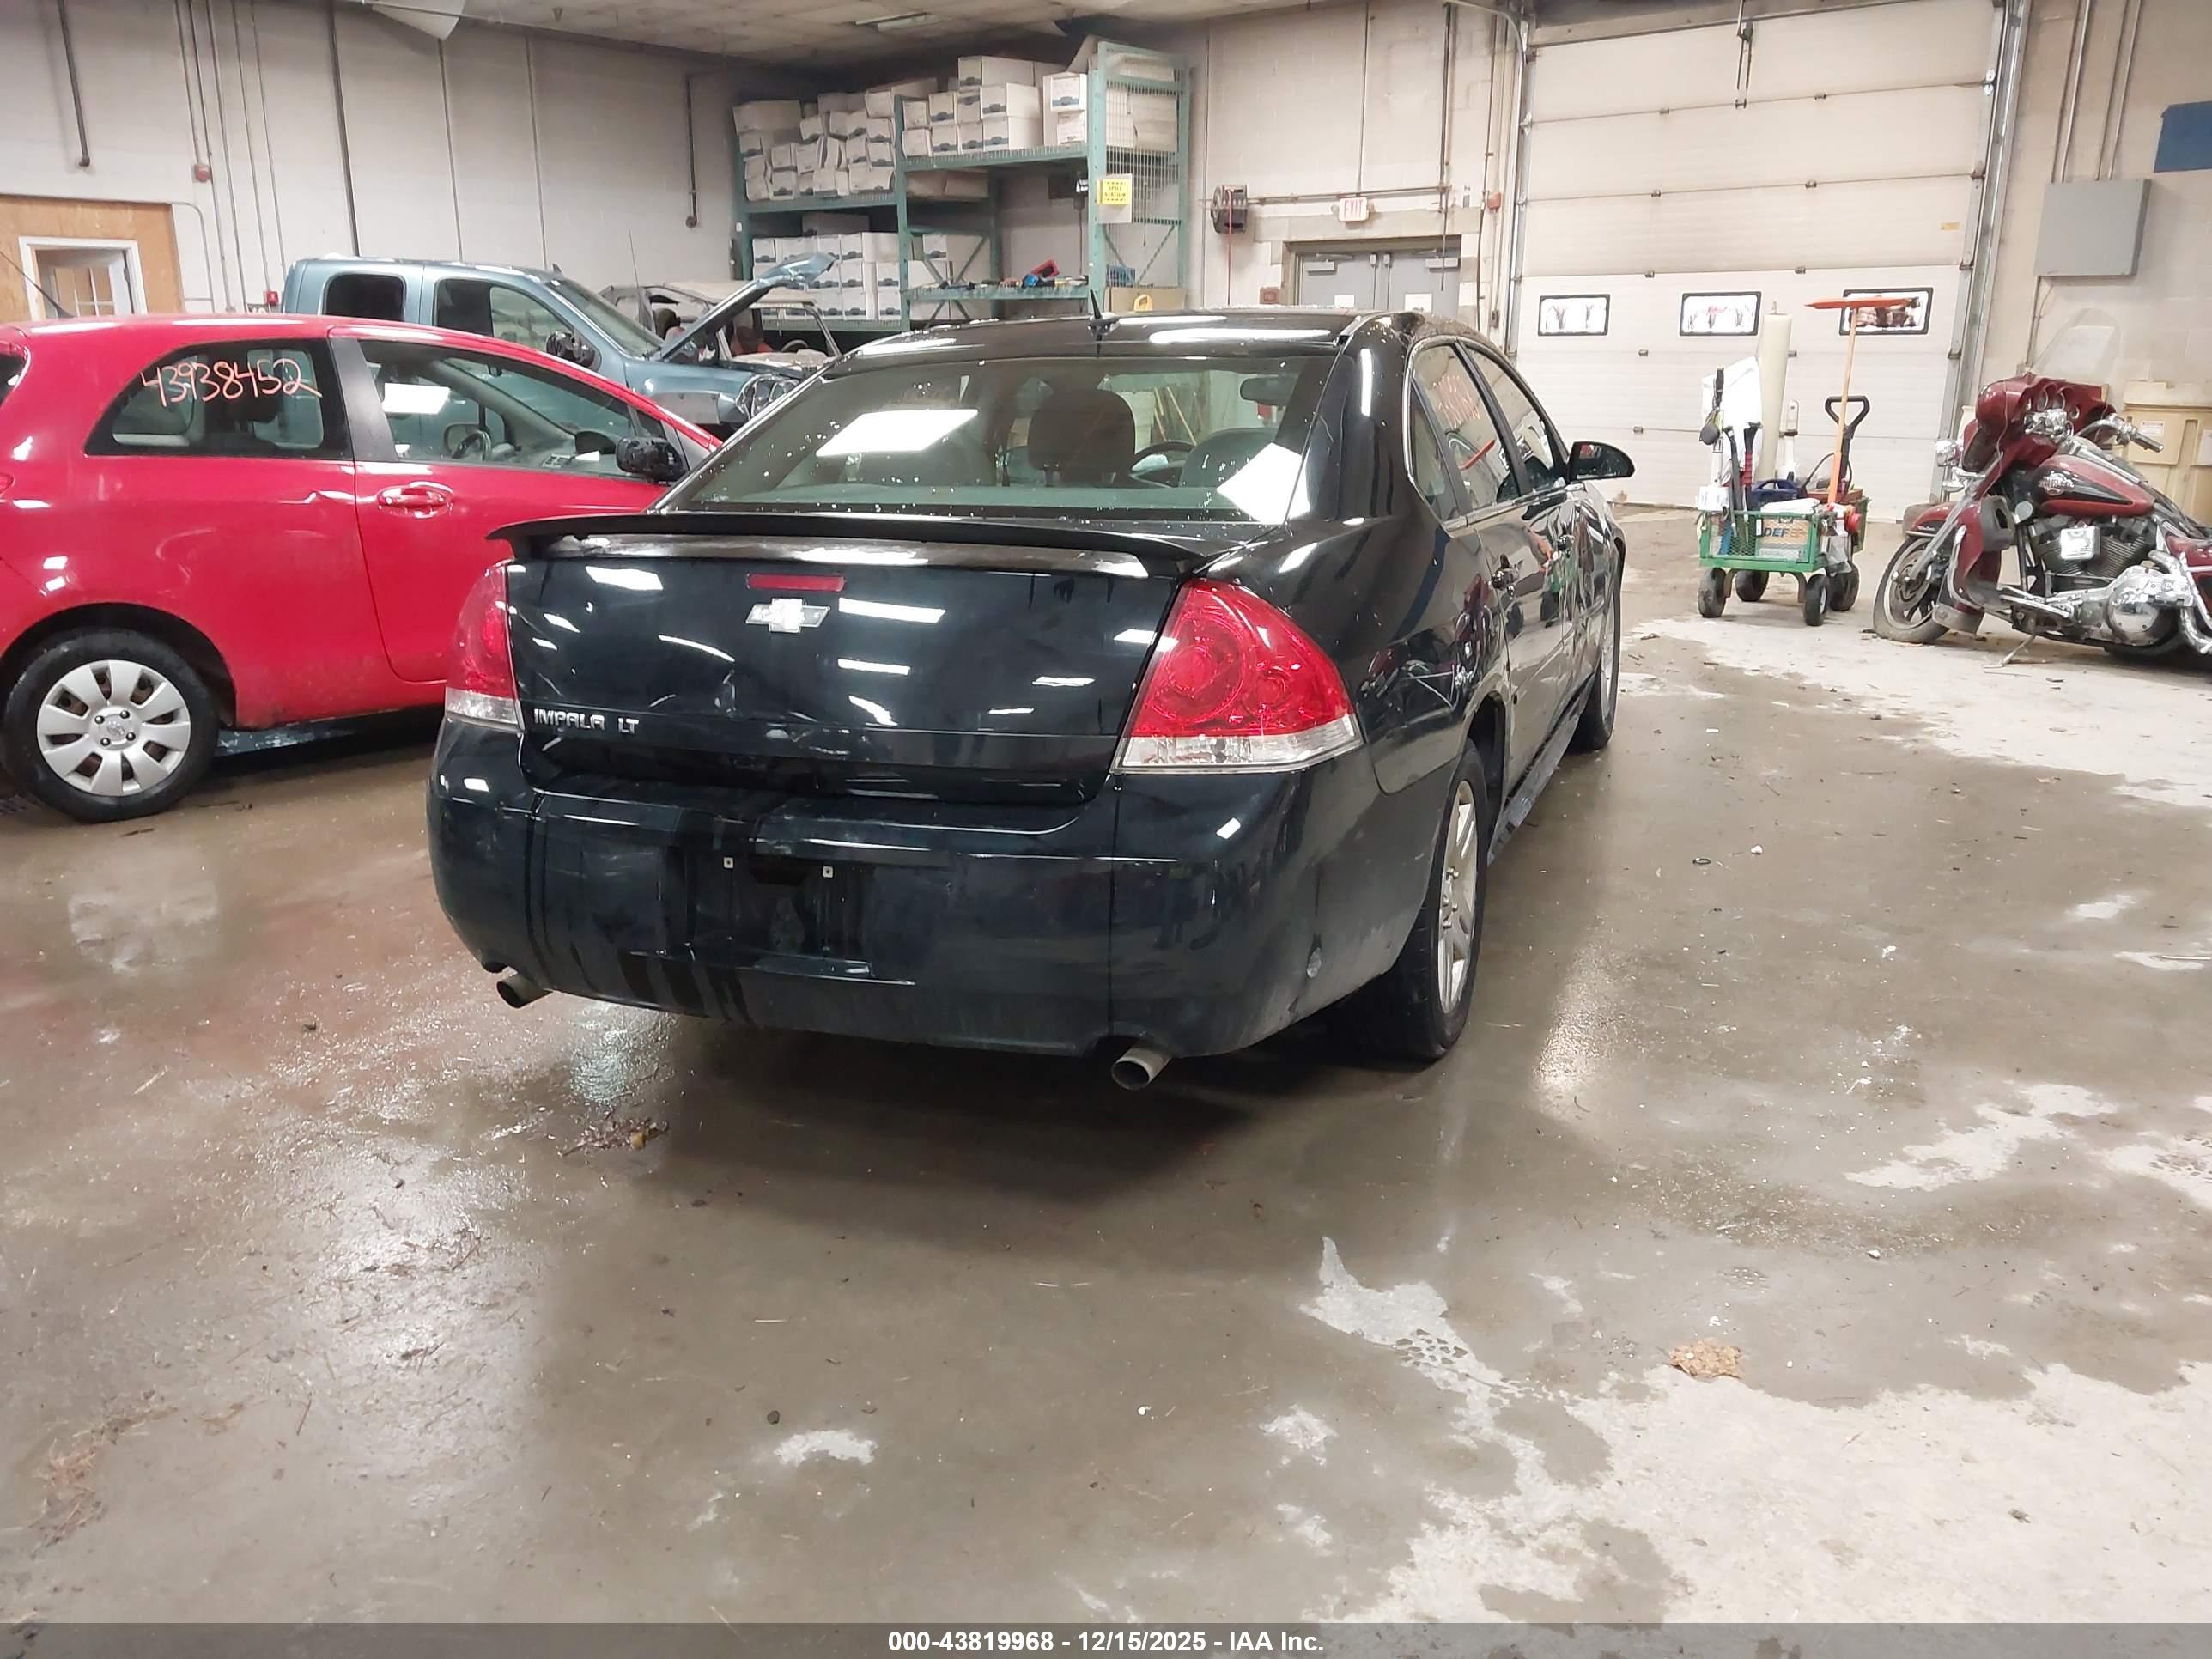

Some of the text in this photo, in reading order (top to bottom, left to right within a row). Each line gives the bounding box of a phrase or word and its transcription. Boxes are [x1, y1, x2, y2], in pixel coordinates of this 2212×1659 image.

[1343, 198, 1364, 218] EXIT
[140, 358, 322, 406] 43938452
[534, 708, 640, 734] IMPALA LT
